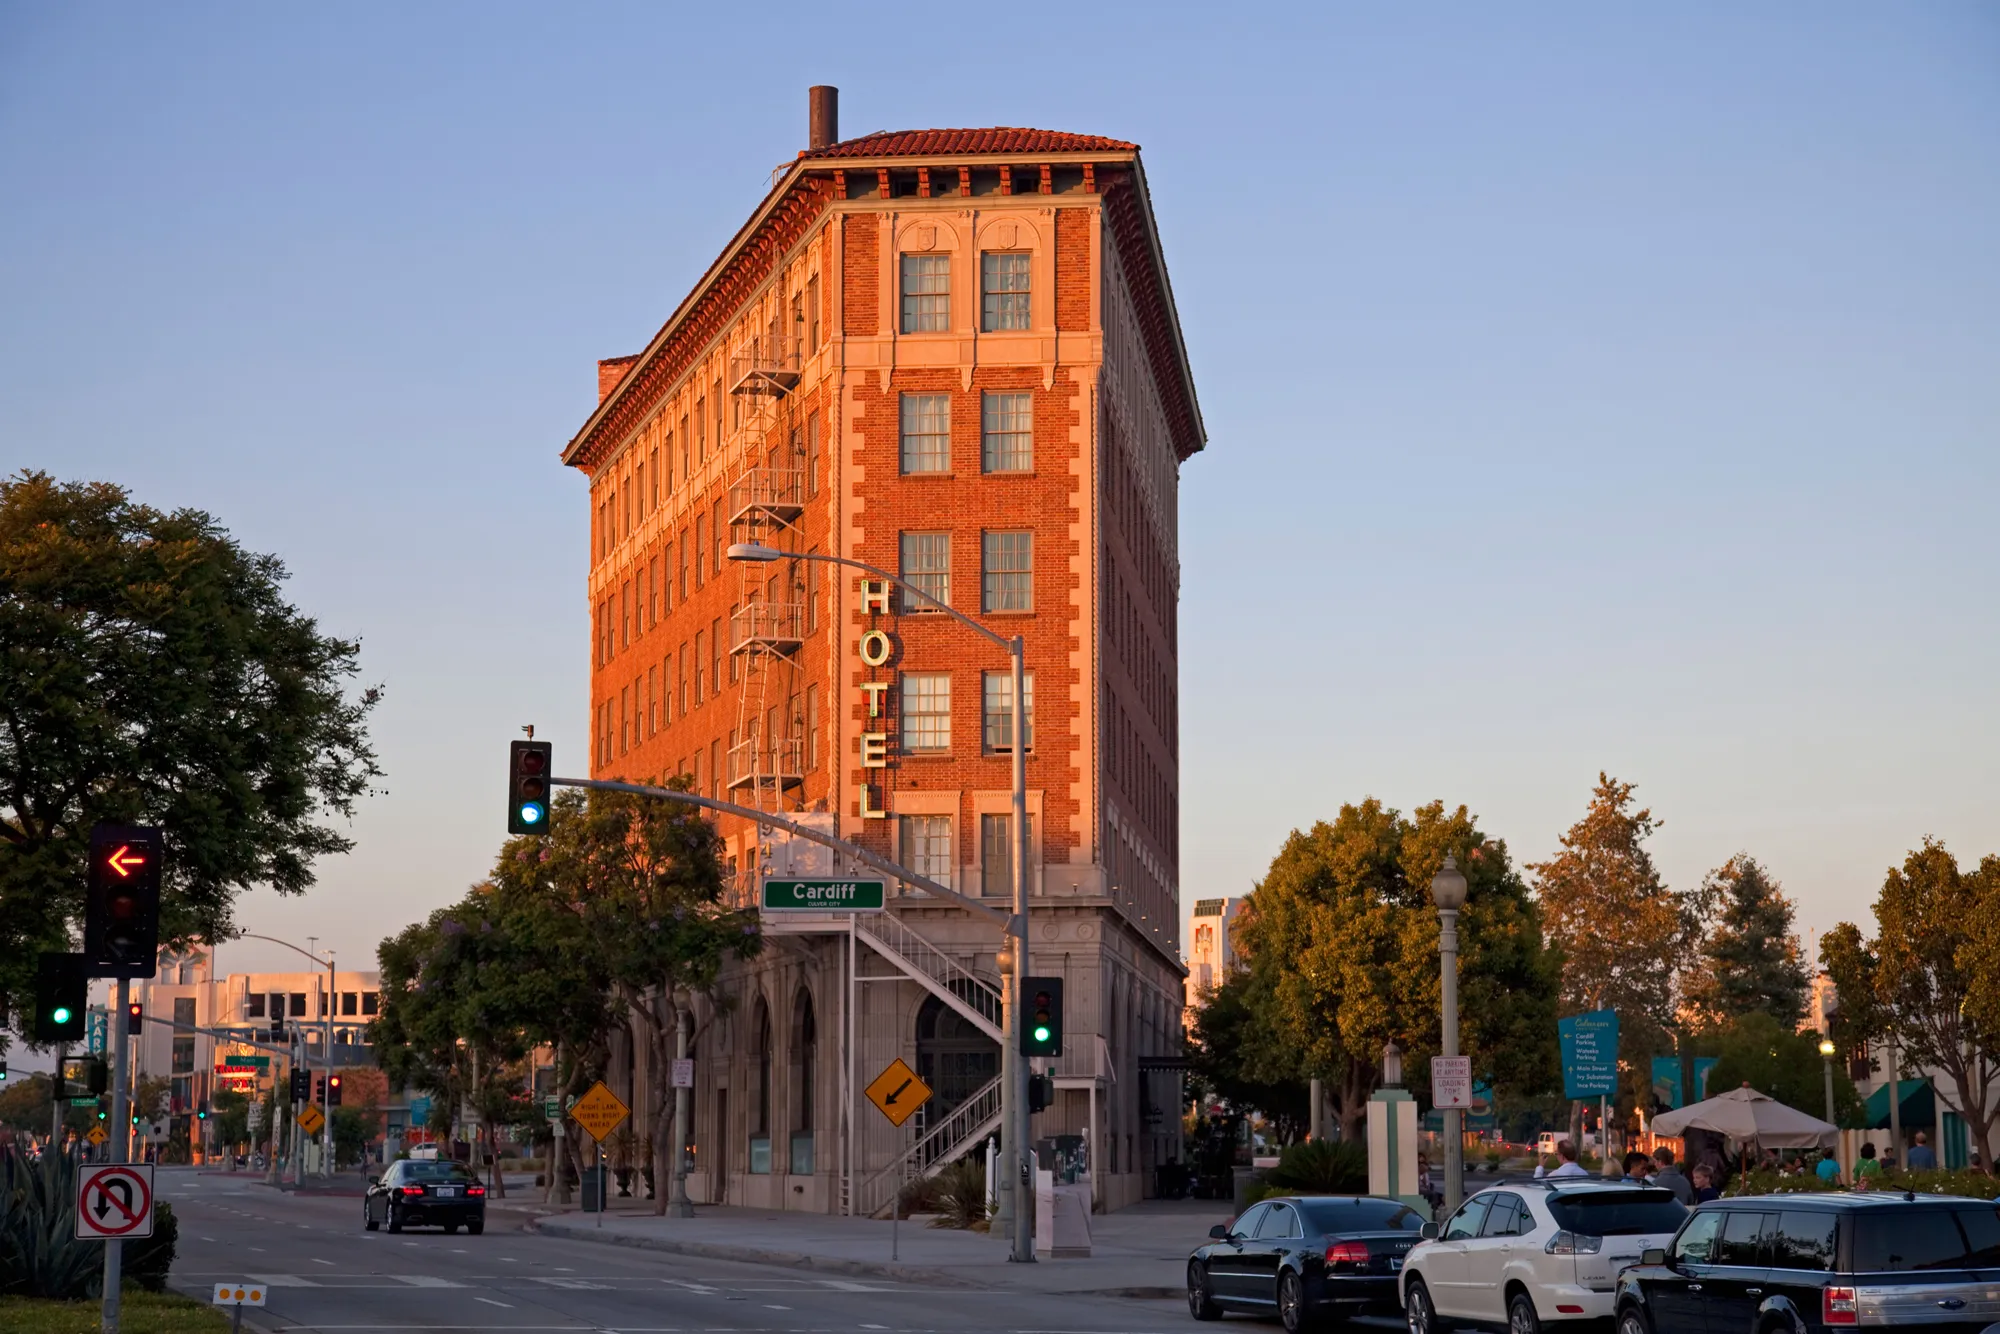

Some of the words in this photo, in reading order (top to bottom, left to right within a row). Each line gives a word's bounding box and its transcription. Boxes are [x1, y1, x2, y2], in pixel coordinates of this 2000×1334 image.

[859, 580, 890, 819] HOTEL
[793, 883, 856, 899] Cardiff
[1444, 1068, 1467, 1076] ANYTIME
[1589, 1082, 1610, 1090] Parking
